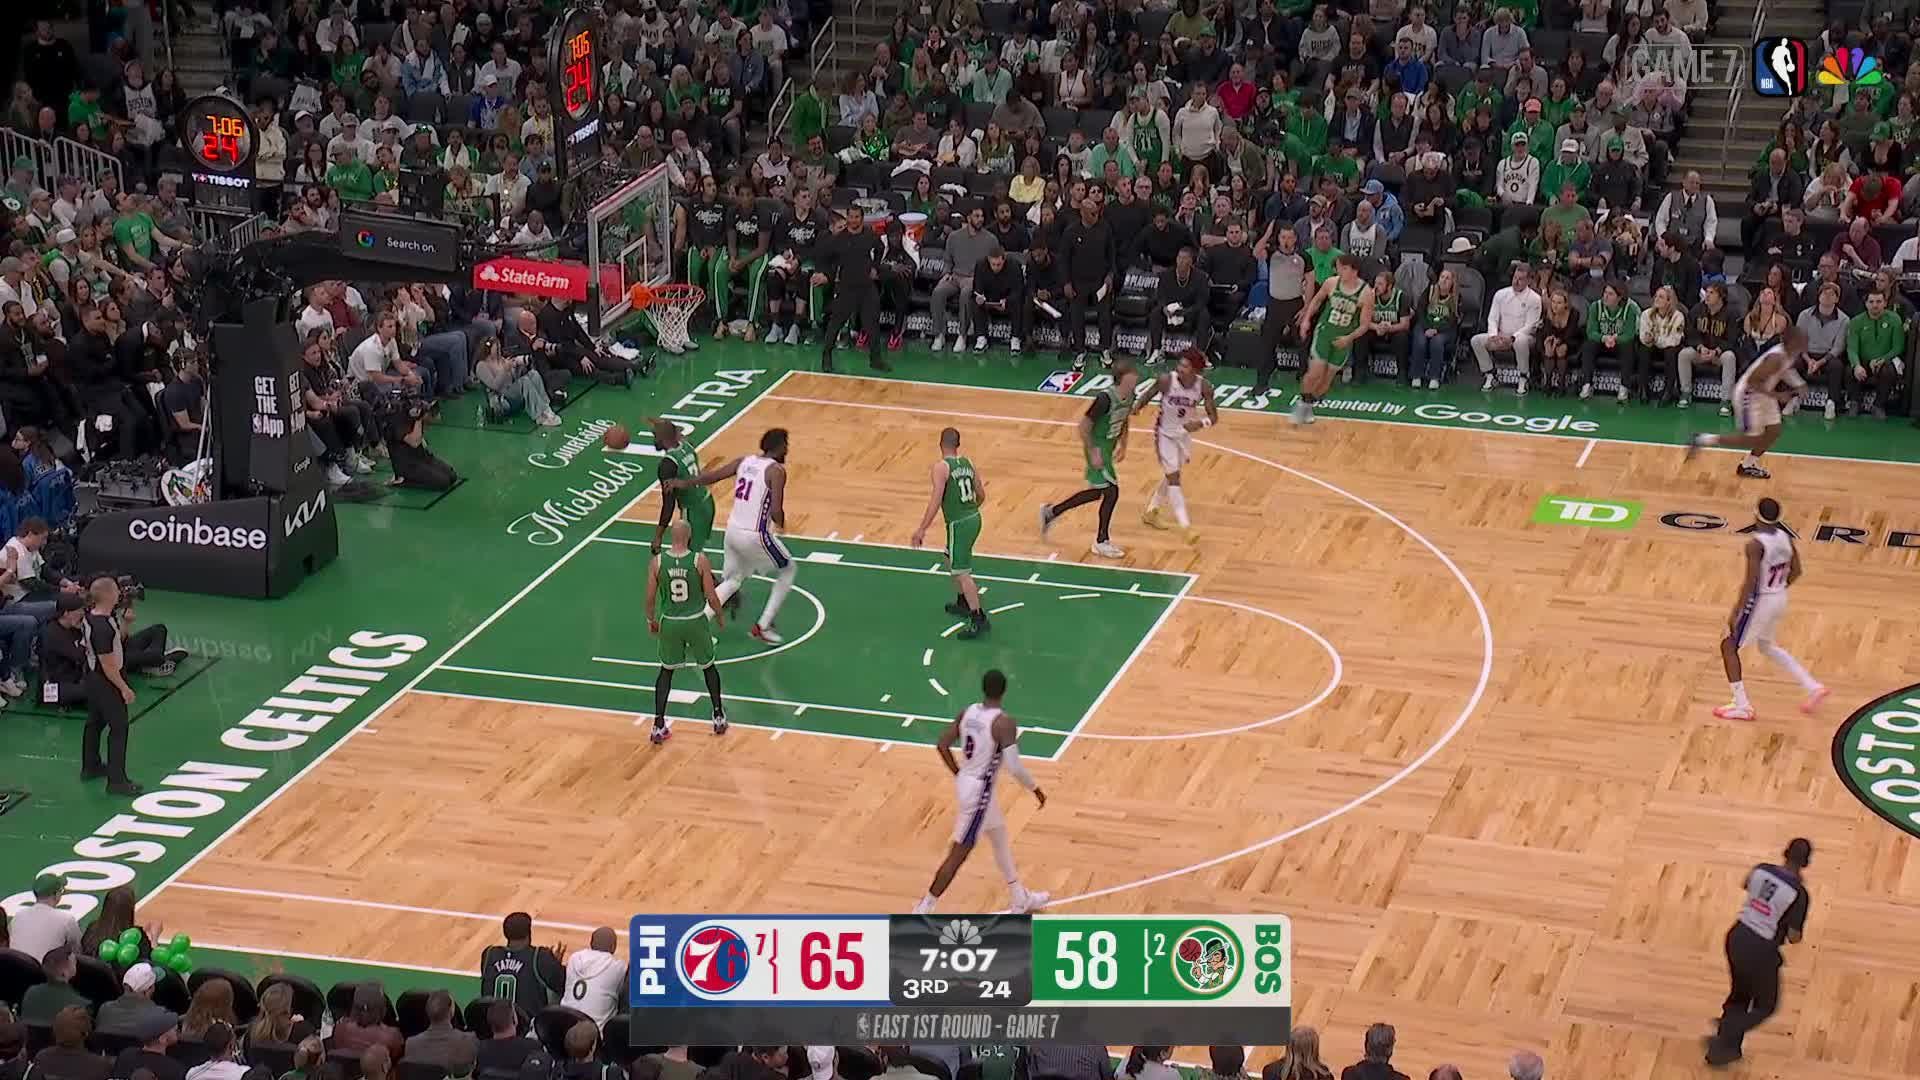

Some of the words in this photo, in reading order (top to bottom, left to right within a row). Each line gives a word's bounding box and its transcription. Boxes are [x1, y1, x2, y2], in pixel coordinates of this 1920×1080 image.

[565, 57, 592, 112] 24
[206, 115, 243, 137] 7:06
[203, 132, 239, 162] 24
[207, 174, 250, 188] TISSOT
[1511, 182, 1519, 192] 0
[387, 236, 420, 250] Search
[421, 243, 437, 253] on.
[1116, 334, 1147, 343] BOSTON
[1117, 342, 1145, 350] CELTICS
[254, 376, 275, 395] GET
[256, 395, 278, 414] THE
[263, 414, 284, 438] App
[1382, 402, 1407, 416] by
[1414, 403, 1600, 433] Google
[528, 417, 616, 469] Courtside
[735, 477, 754, 501] 21
[958, 478, 973, 503] 11
[506, 458, 643, 545] Michelob
[1549, 500, 1629, 523] TD
[128, 515, 267, 550] coinbase
[668, 567, 688, 578] WHITE
[670, 578, 689, 603] 9
[220, 630, 428, 751] CELTICS
[1855, 697, 1920, 826] OSTO
[494, 959, 524, 973] TATUM
[573, 980, 587, 1000] 0
